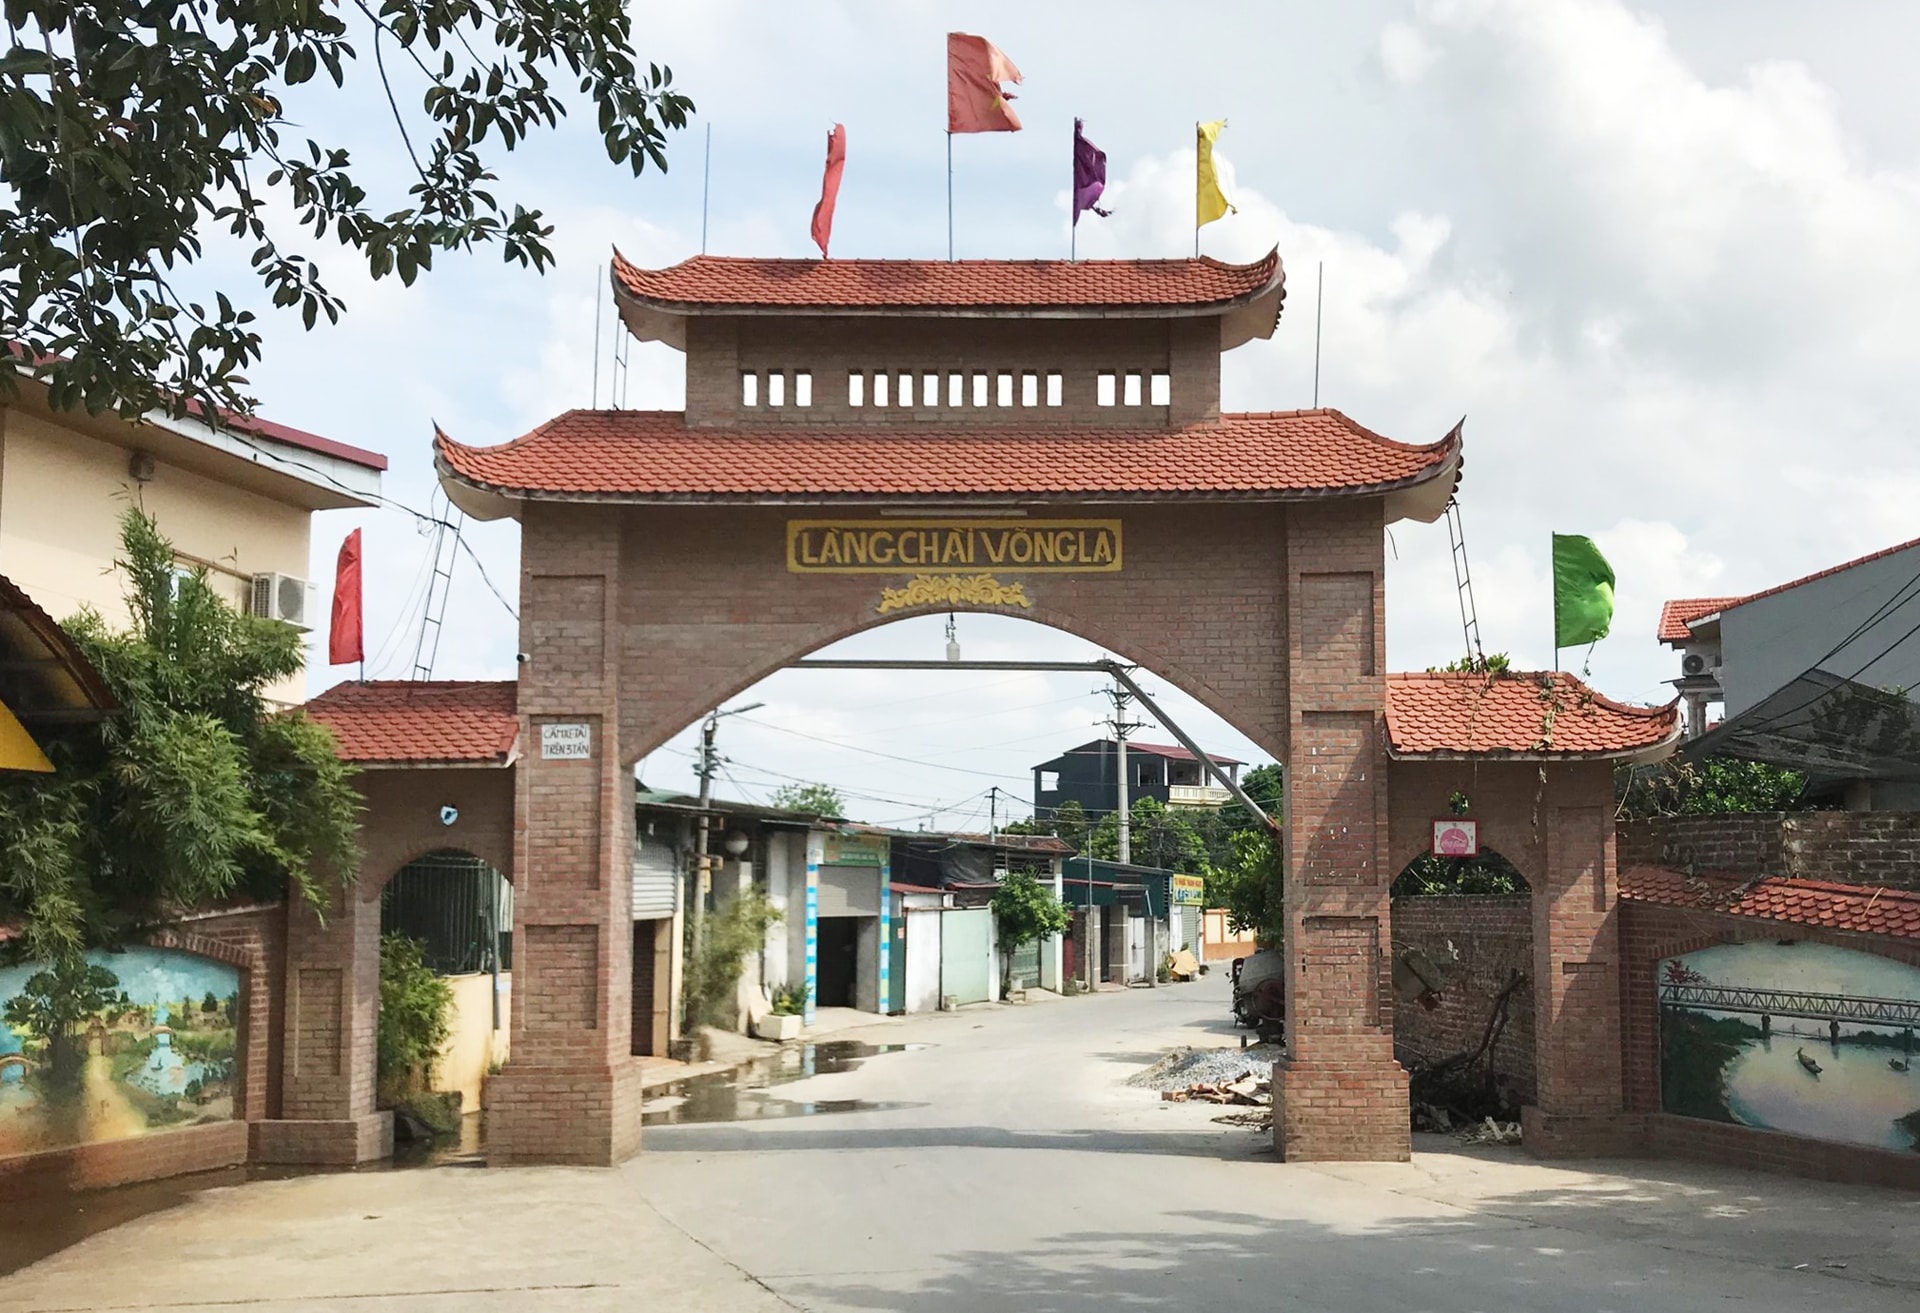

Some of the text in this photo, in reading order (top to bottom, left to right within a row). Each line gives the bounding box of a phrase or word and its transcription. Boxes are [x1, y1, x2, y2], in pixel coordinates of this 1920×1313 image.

[801, 526, 1113, 564] LÀNG CHÀI VÕNG LA
